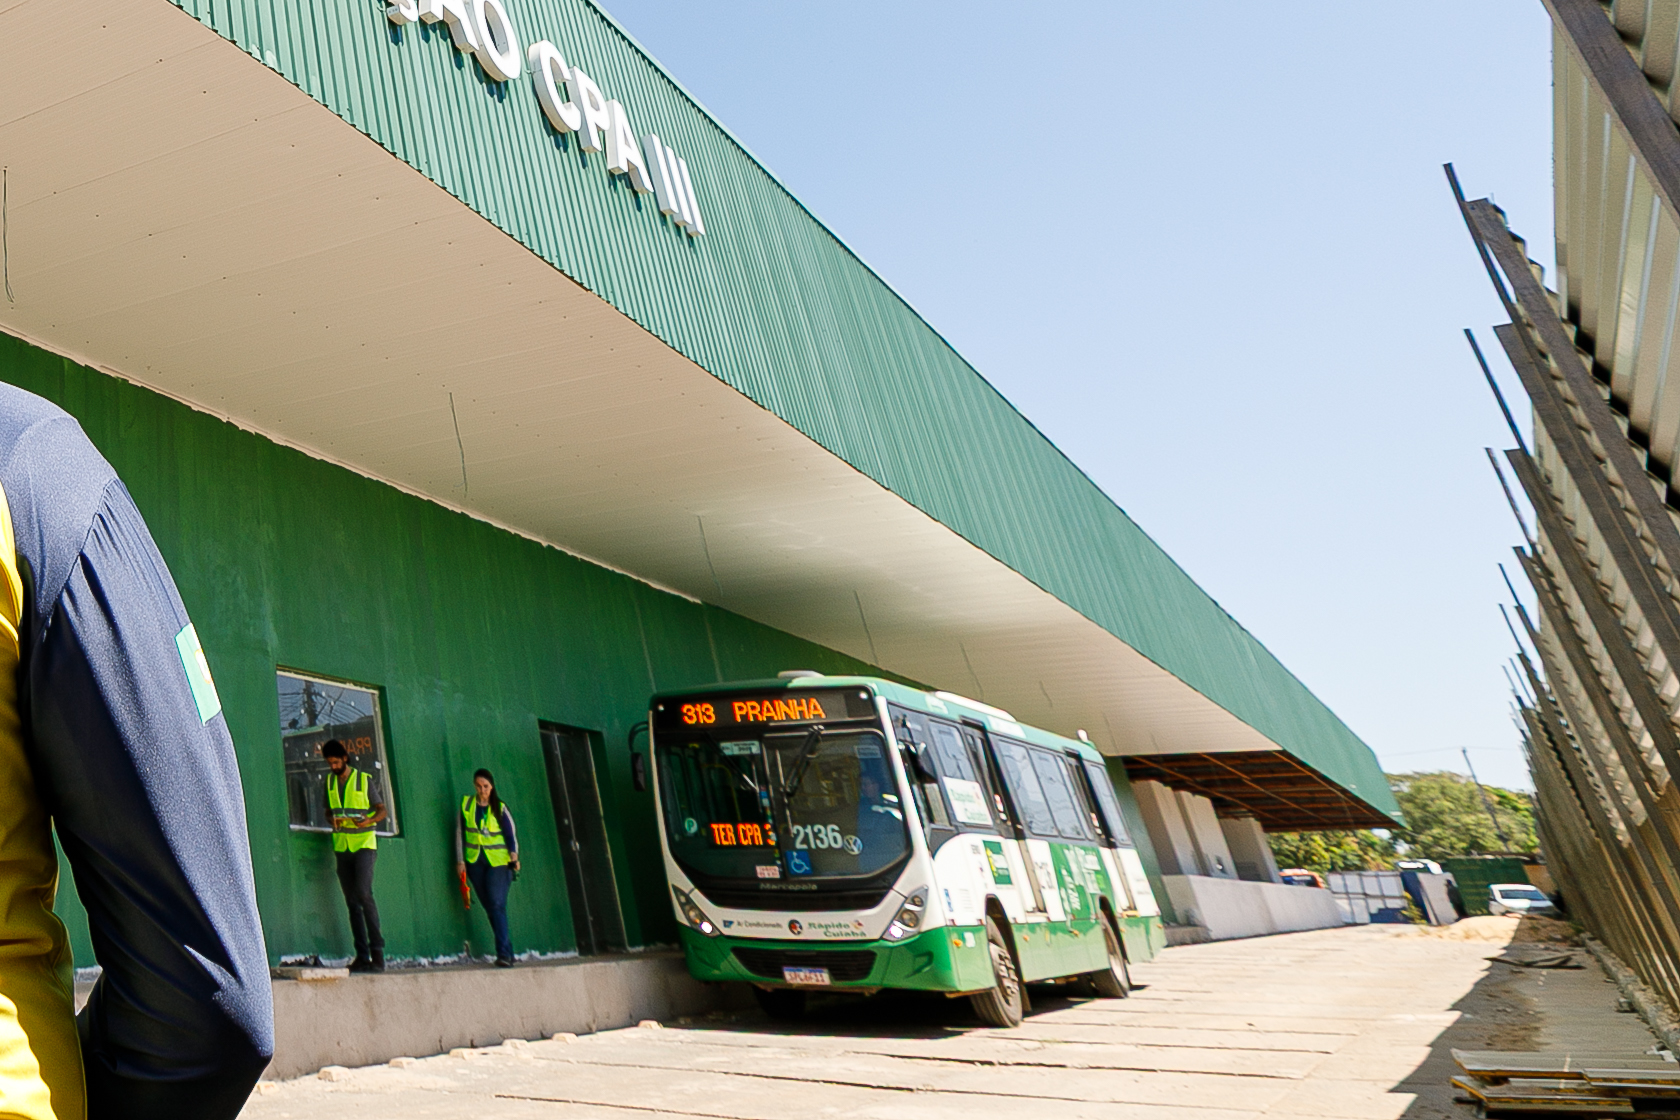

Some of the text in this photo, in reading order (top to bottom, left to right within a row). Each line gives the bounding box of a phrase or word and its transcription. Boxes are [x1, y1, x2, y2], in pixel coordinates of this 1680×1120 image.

[528, 39, 653, 195] CPA
[641, 133, 706, 237] III
[681, 697, 827, 725] 313 PRAINHA
[710, 823, 737, 846] TER
[737, 822, 763, 846] CPA
[792, 824, 843, 850] 2136
[759, 883, 818, 891] Marcopolo
